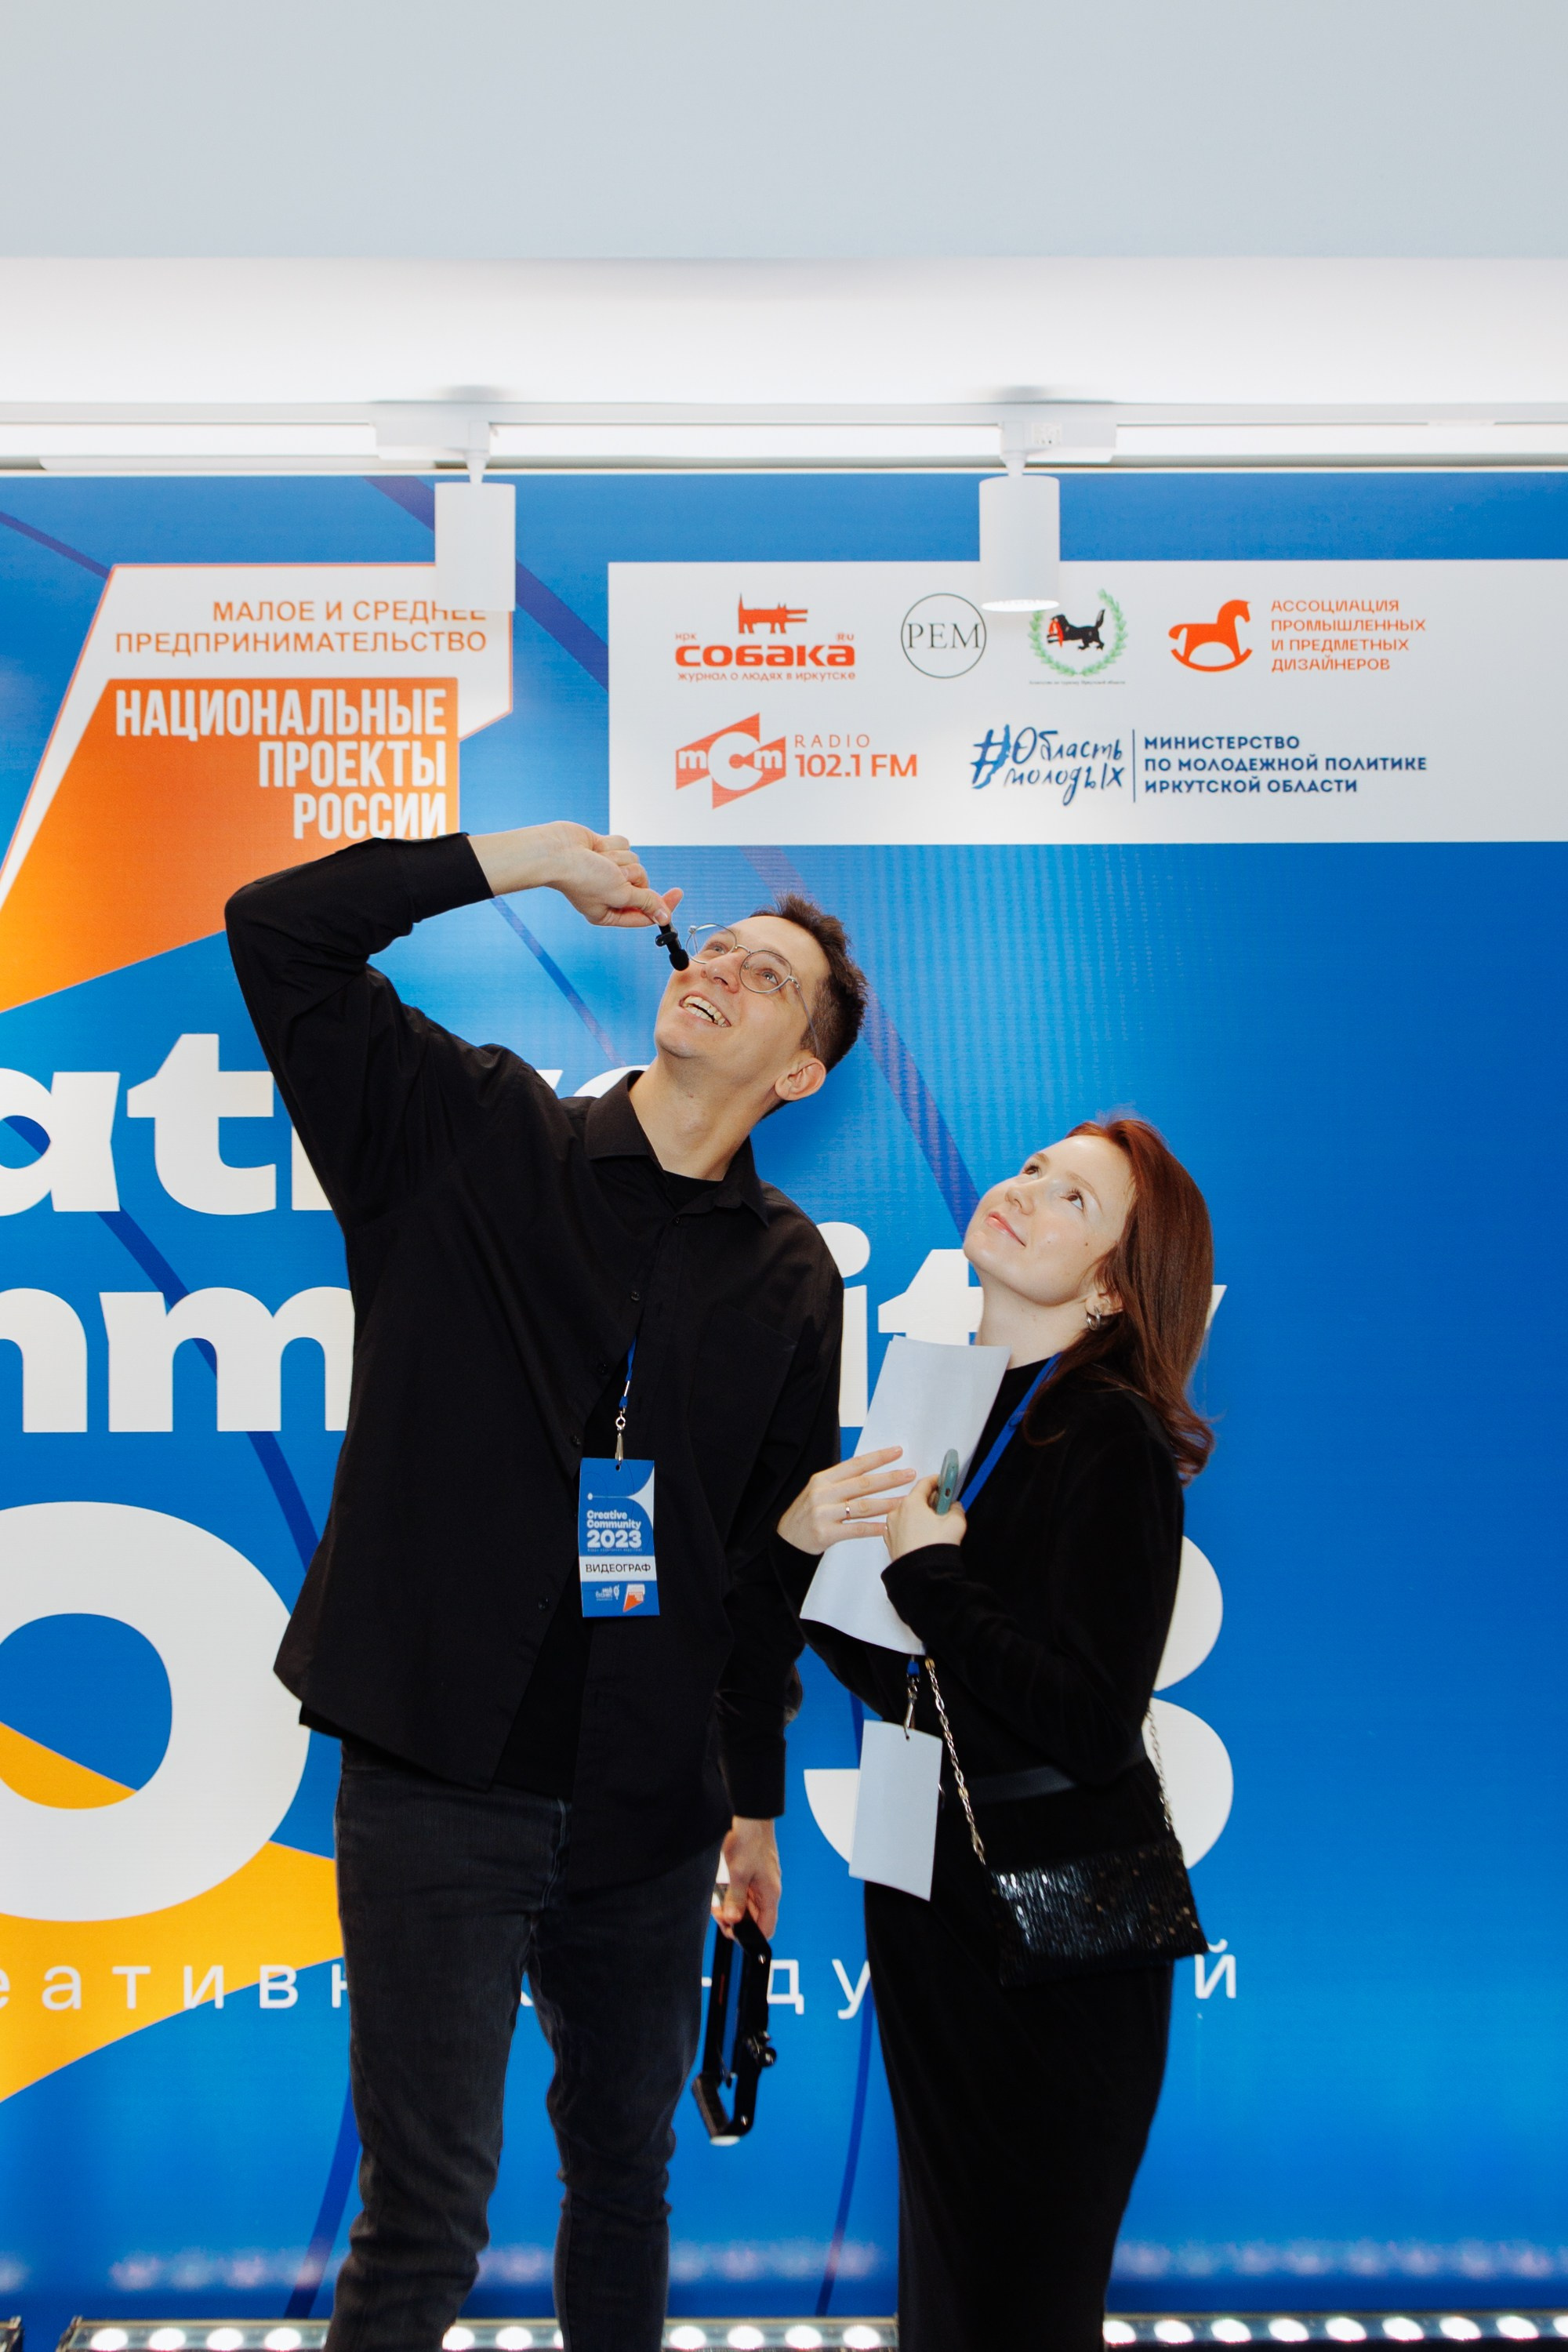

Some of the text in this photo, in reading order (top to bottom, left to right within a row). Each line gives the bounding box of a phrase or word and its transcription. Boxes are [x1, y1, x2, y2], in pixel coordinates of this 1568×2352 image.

[212, 601, 314, 622] МАЛОЕ
[325, 601, 343, 622] И
[1271, 599, 1399, 615] АССОЦИАЦИЯ
[1271, 619, 1426, 632] ПРОМЫШЛЕННЫХ
[115, 630, 487, 658] ПРЕДПРИНИМАТЕЛЬСТВО
[1271, 638, 1409, 653] И ПРЕДМЕТНЫХ
[674, 644, 855, 668] собака
[1271, 655, 1391, 673] ДИЗАЙНЕРОВ
[677, 671, 856, 683] журнал о людях в иркутске
[115, 689, 447, 741] НАЦИОНАЛЬНЫЕ
[794, 733, 870, 749] RADIO
[1144, 735, 1300, 750] МИНИСТЕРСТВО
[260, 740, 447, 788] ПРОЕКТЫ
[794, 753, 917, 778] 102.1 FM
[1145, 753, 1427, 773] ПО МОЛОДЕЖНОЙ ПОЛИТИКЕ
[1145, 775, 1357, 793] ИРКУТСКОЙ ОБЛАСТИ
[292, 792, 447, 839] РОССИИ
[586, 1509, 627, 1519] Creative
[586, 1519, 641, 1530] Community
[586, 1530, 642, 1548] 2023
[585, 1563, 652, 1574] ВИДЕОГРАФ
